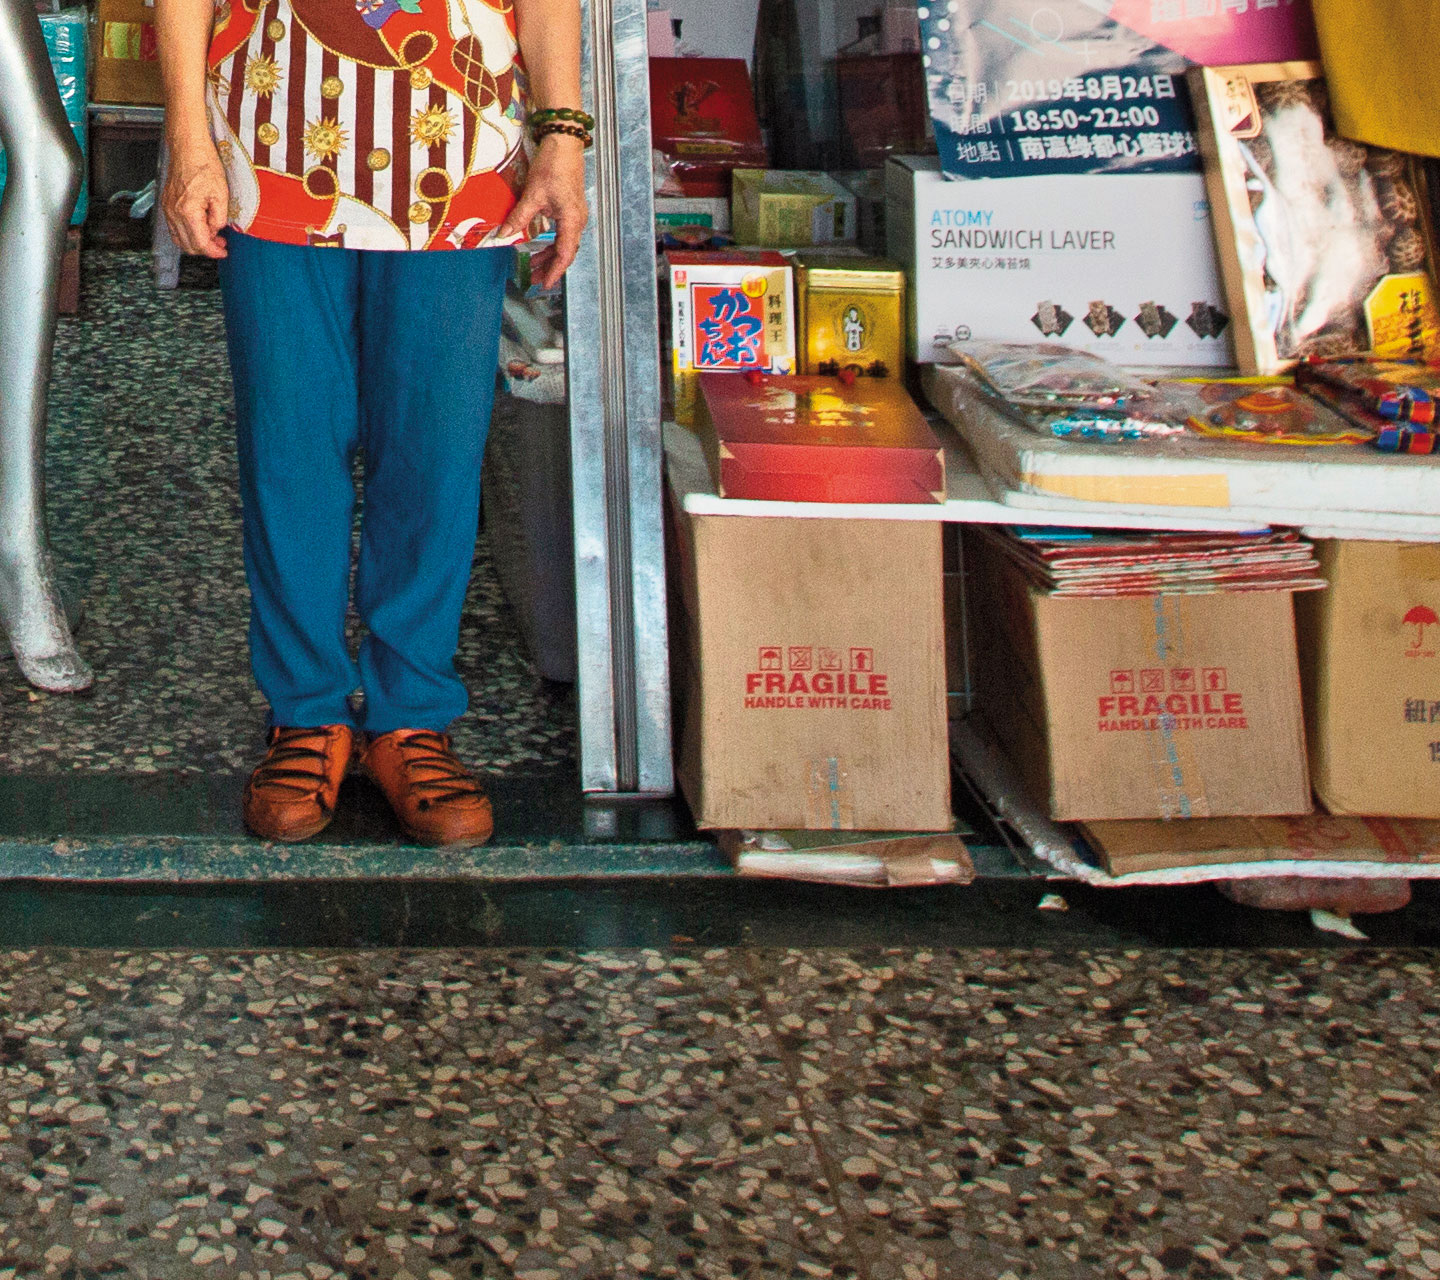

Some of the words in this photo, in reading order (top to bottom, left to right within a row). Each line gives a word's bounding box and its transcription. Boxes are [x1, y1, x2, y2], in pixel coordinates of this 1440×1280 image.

[1005, 74, 1176, 103] 2019年8月24日
[1010, 105, 1160, 132] 18:50~22:00
[930, 209, 995, 227] ATOMY
[930, 229, 1043, 250] SANDWICH
[1050, 229, 1116, 250] LAVER
[745, 673, 889, 696] FRAGILE
[744, 697, 805, 709] HANDLE
[808, 697, 848, 709] WITH
[850, 698, 892, 710] CARE
[1097, 692, 1245, 717] FRAGILE
[1097, 718, 1161, 733] HANDLE
[1206, 716, 1249, 730] CARE
